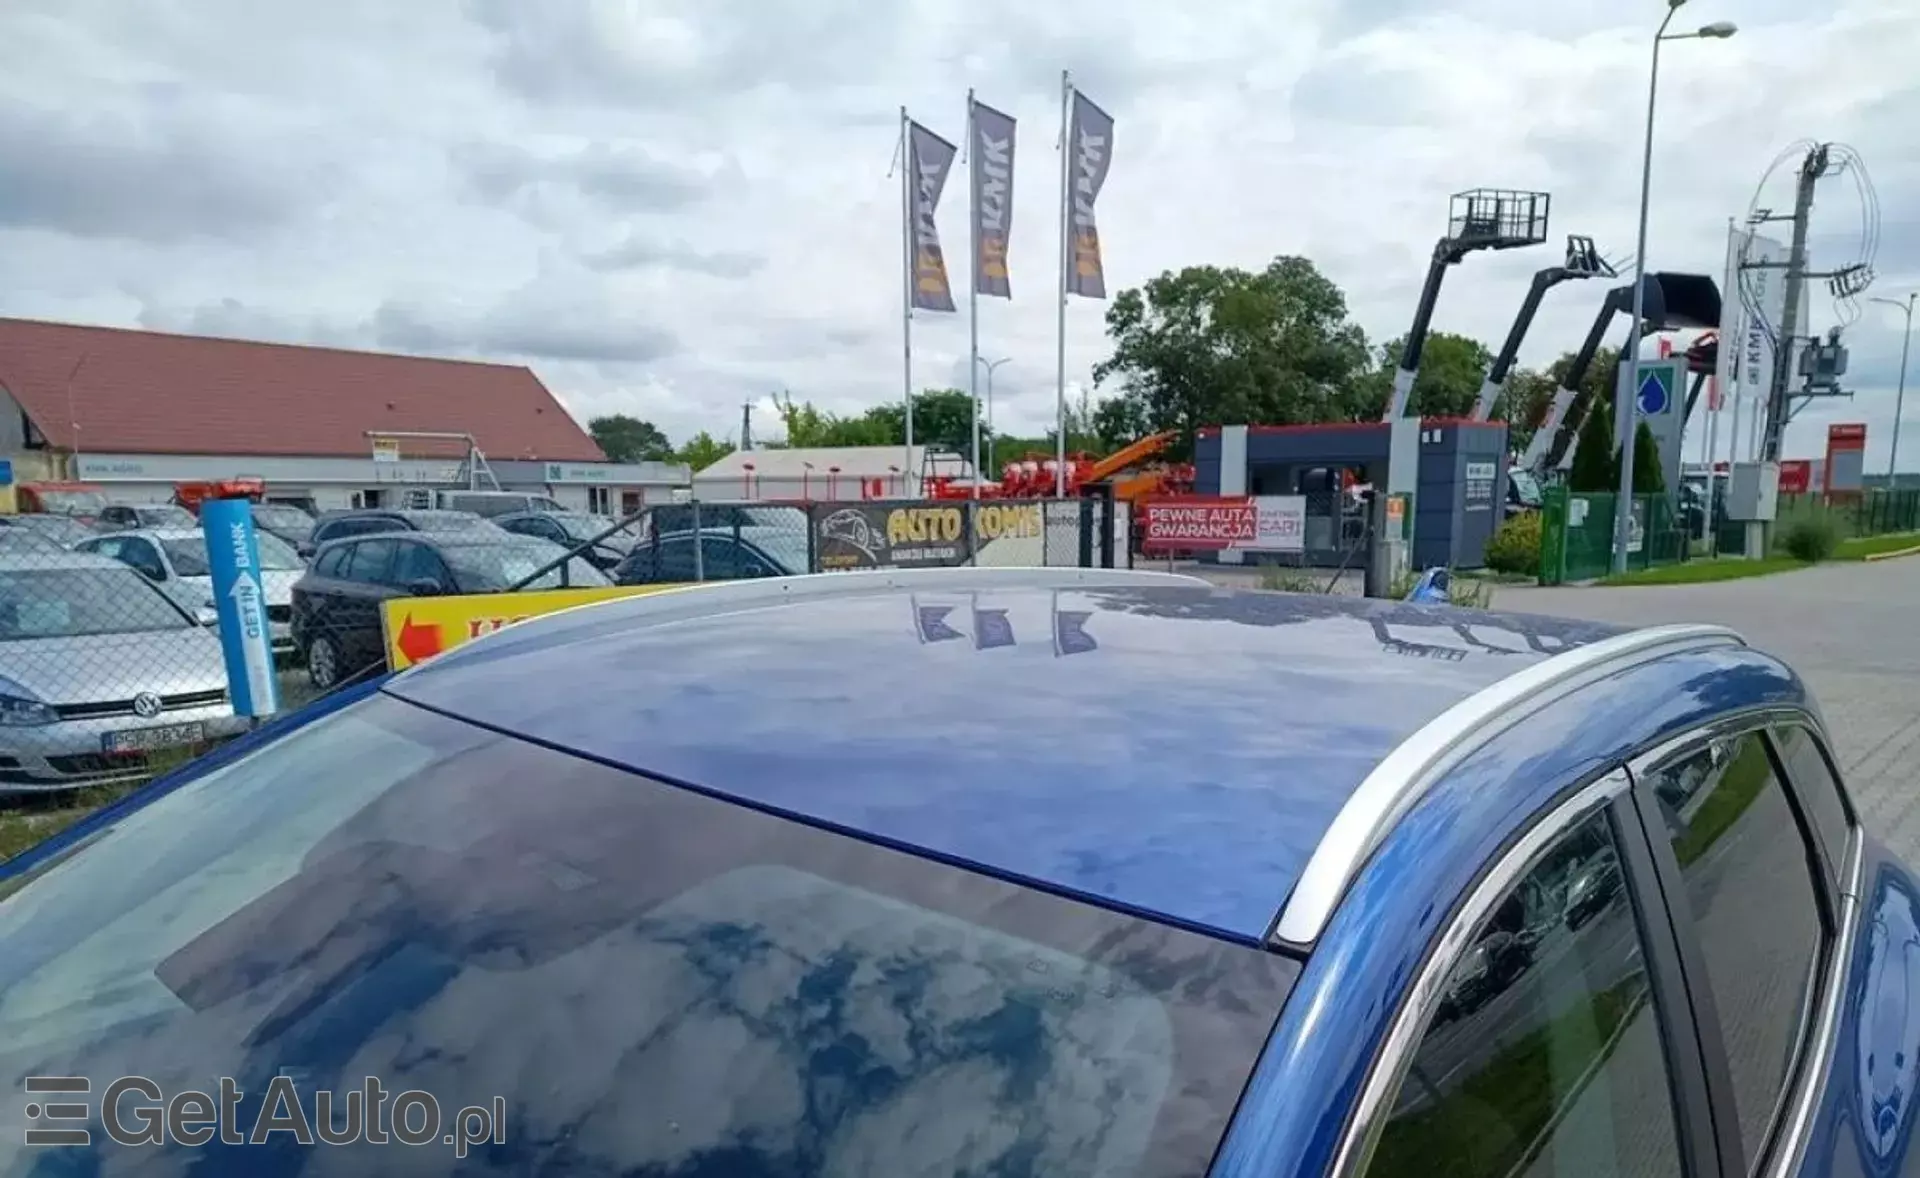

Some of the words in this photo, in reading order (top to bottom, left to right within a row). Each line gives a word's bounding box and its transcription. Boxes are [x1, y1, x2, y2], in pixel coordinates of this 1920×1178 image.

[887, 508, 961, 547] AUTO
[1150, 509, 1206, 522] PEWNE
[1210, 509, 1254, 522] AUTA
[231, 521, 251, 567] BANK
[1150, 523, 1253, 538] GWARANCJA
